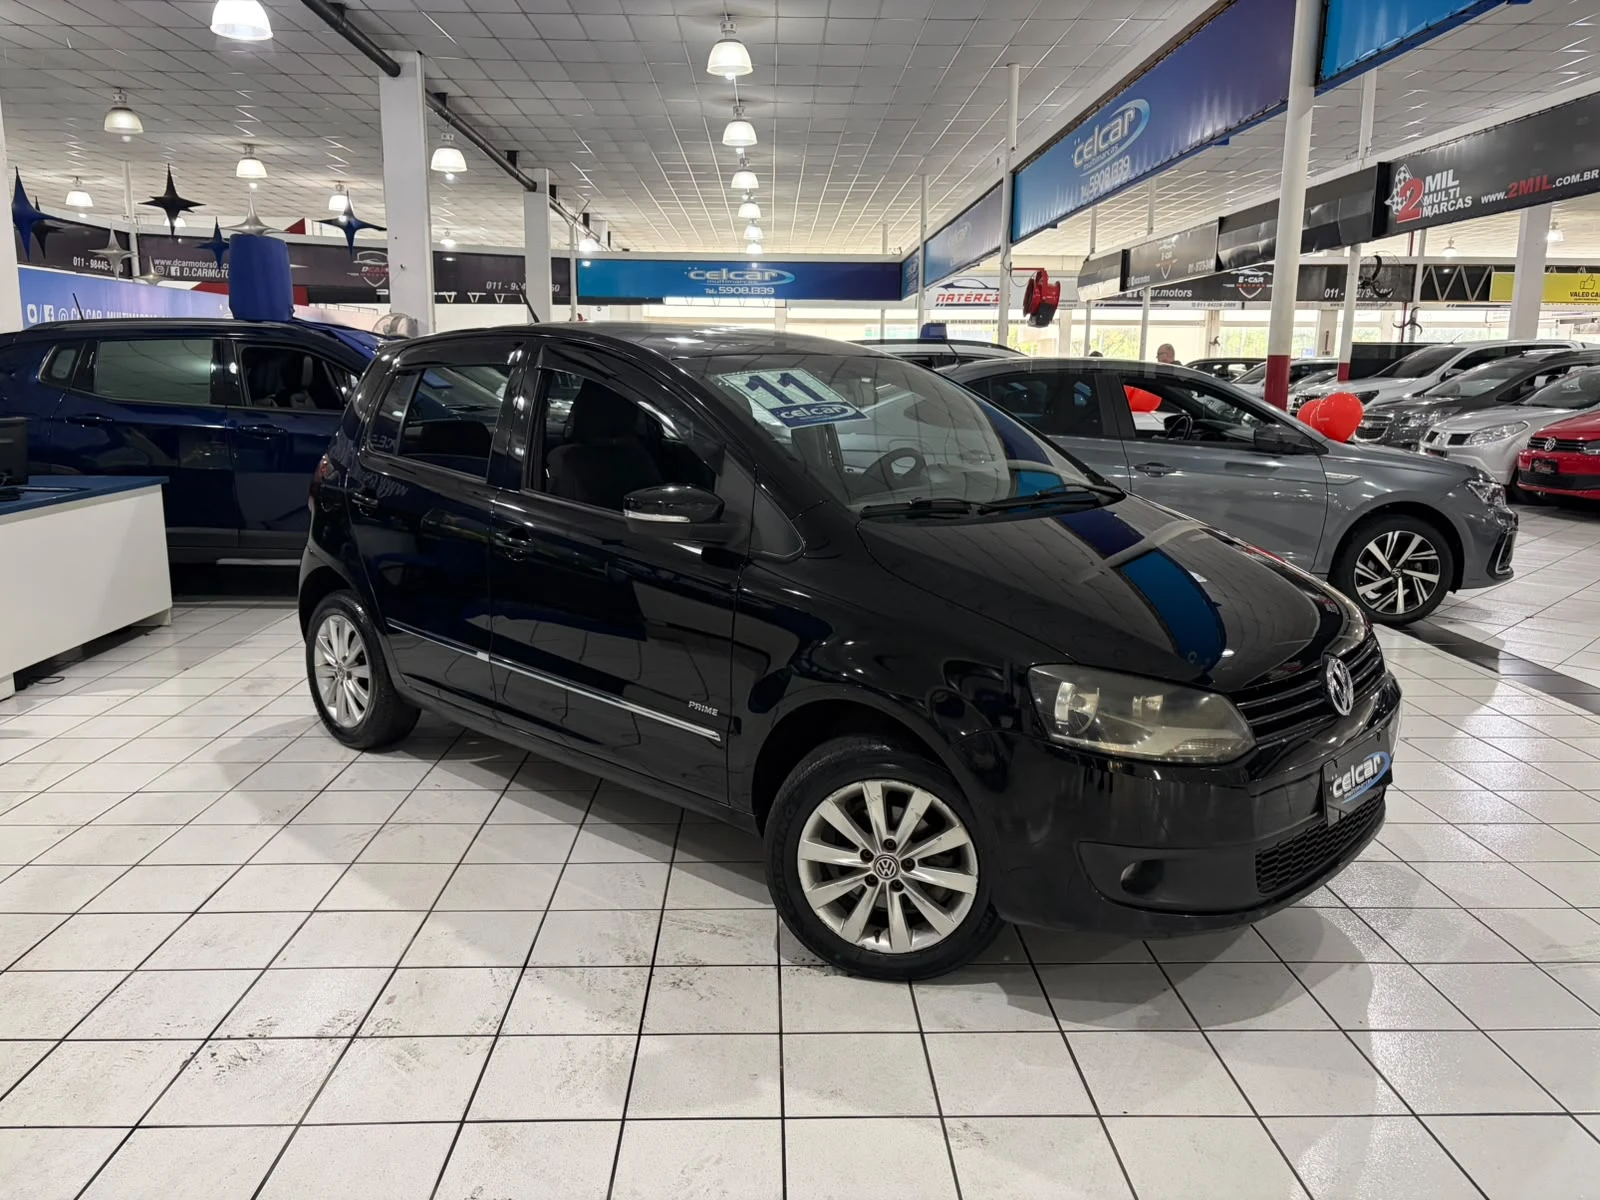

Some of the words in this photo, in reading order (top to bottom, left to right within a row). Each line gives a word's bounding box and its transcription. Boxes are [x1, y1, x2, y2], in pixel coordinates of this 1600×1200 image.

[1073, 106, 1136, 169] celcar
[1424, 169, 1460, 194] MIL
[1423, 186, 1460, 206] MULTI
[1422, 195, 1473, 218] MARCAS
[73, 256, 85, 267] 011
[688, 268, 778, 280] celcar
[486, 281, 502, 290] 011
[1324, 288, 1339, 298] 011
[745, 372, 827, 405] 11
[779, 405, 844, 419] celcar
[688, 700, 719, 717] PRIME
[1332, 753, 1381, 798] celcar
